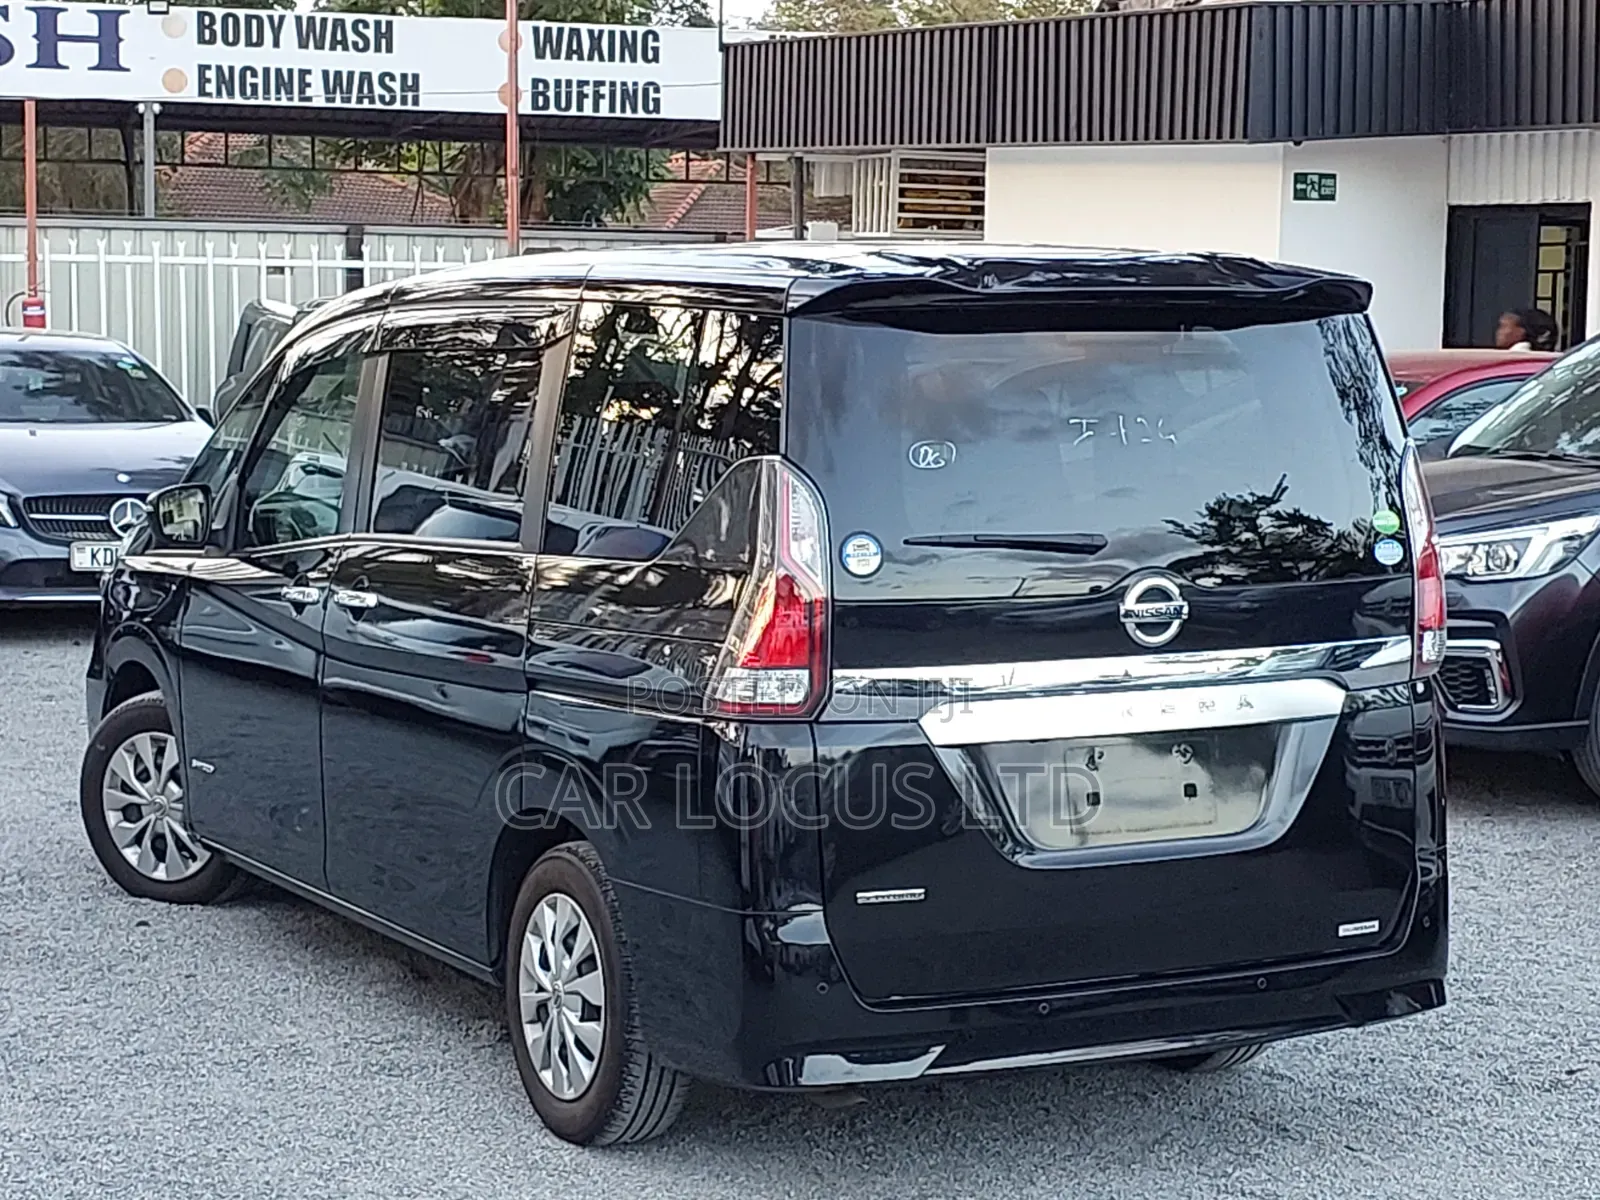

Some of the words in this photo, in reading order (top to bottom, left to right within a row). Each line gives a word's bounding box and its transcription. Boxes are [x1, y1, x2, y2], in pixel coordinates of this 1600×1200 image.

[197, 11, 286, 49] BODY
[295, 15, 394, 54] WASH
[532, 26, 661, 64] WAXING
[197, 64, 313, 102] ENGINE
[321, 69, 420, 107] WASH
[531, 78, 661, 114] BUFFING
[91, 547, 118, 567] KD
[1123, 604, 1184, 619] NISSAN
